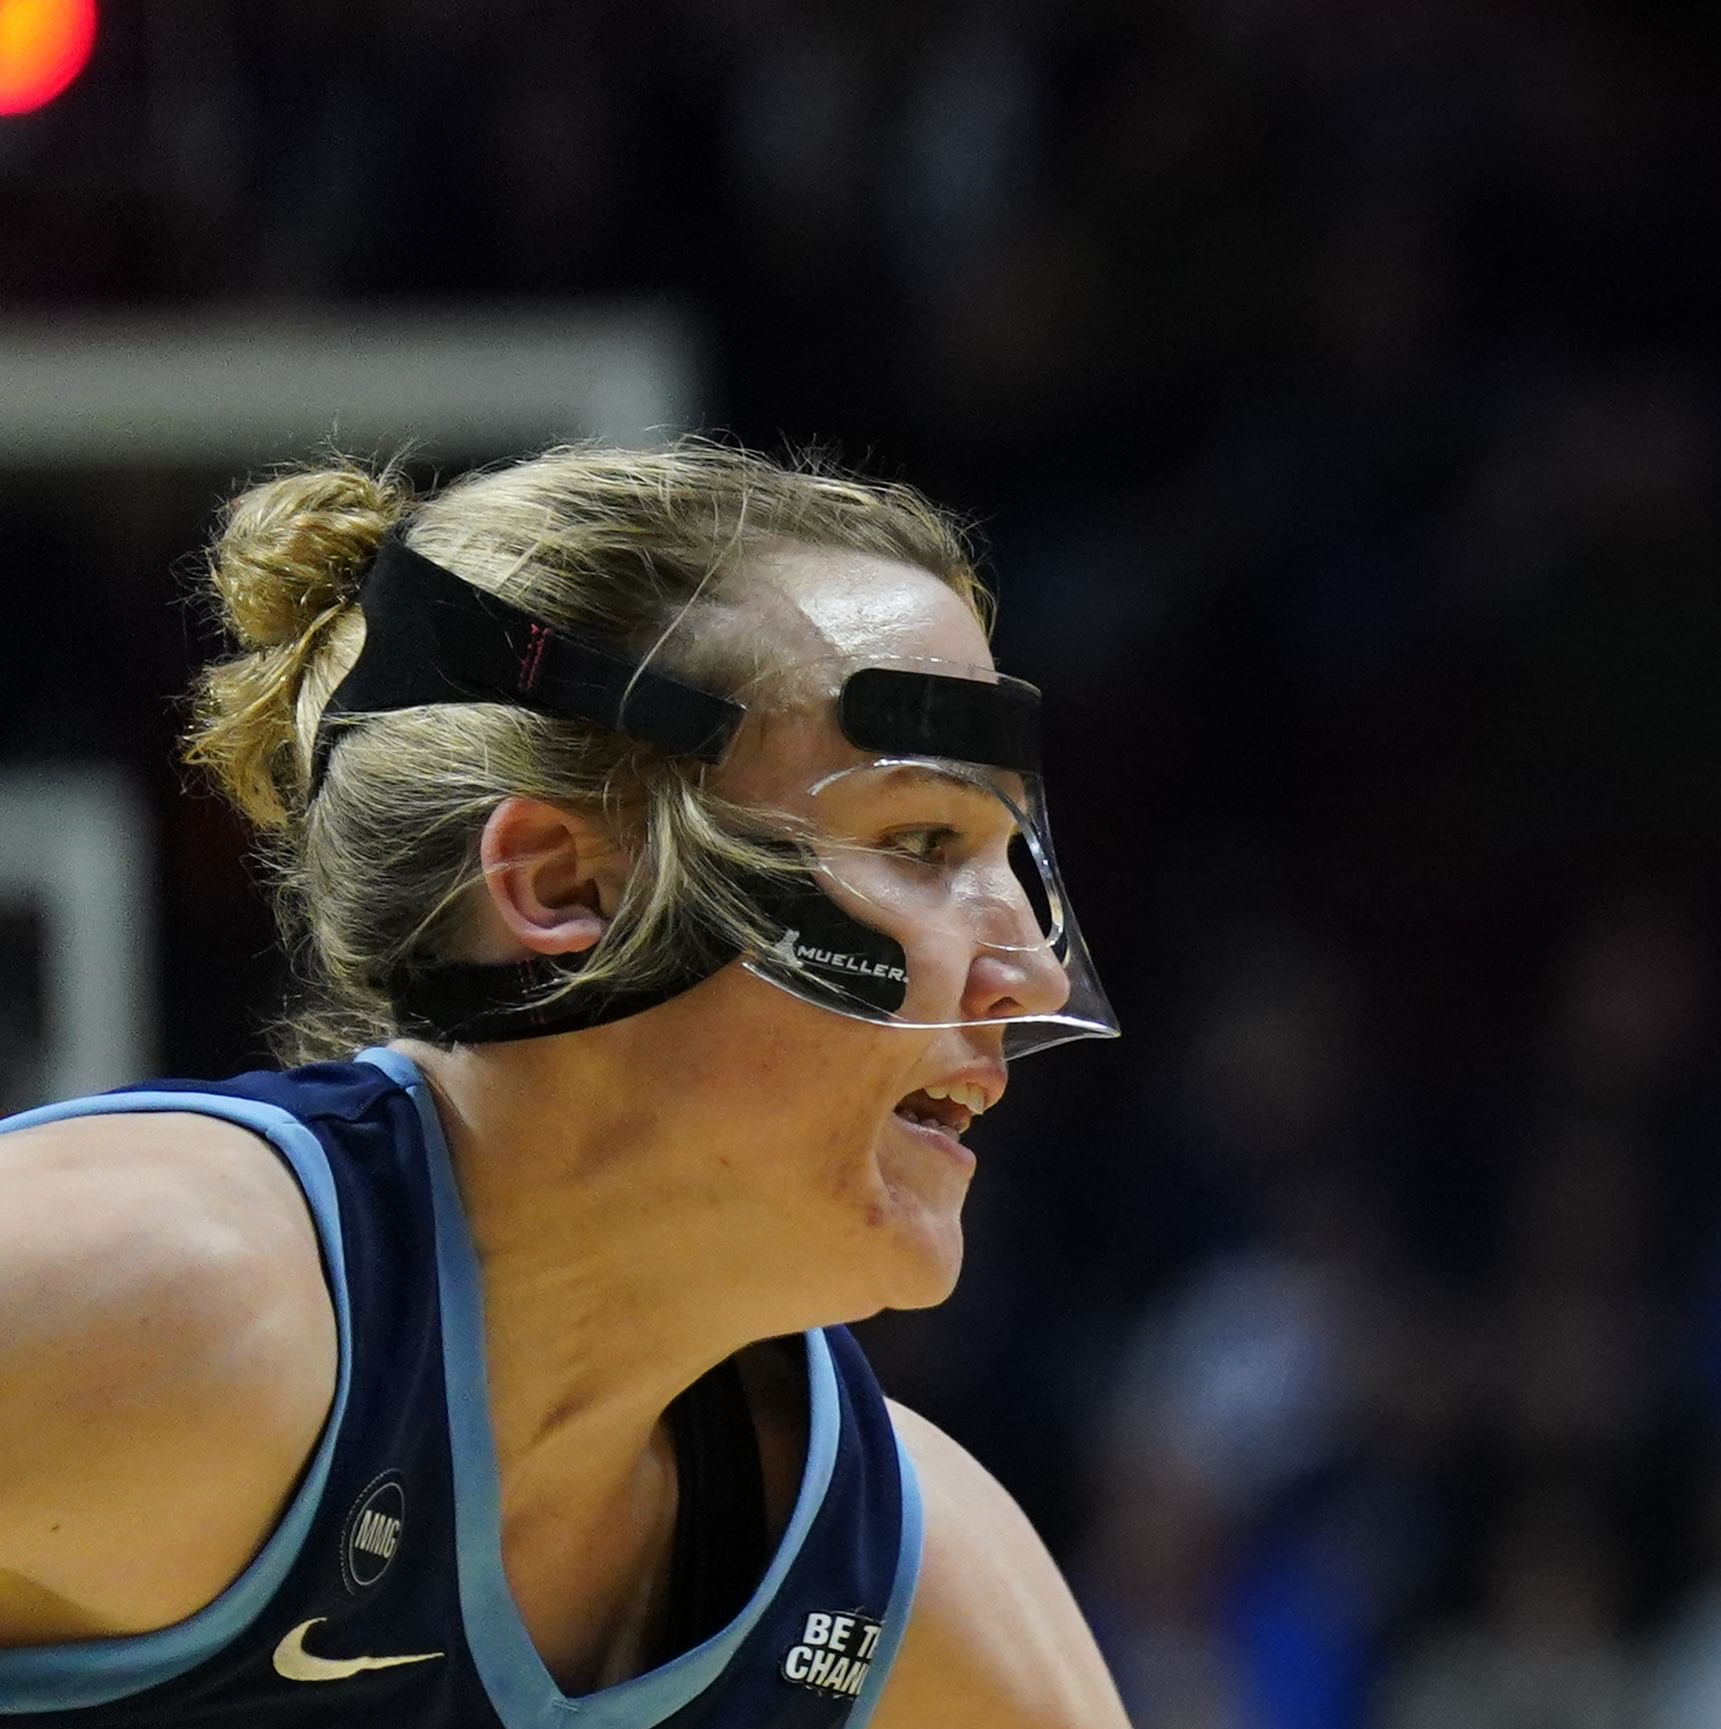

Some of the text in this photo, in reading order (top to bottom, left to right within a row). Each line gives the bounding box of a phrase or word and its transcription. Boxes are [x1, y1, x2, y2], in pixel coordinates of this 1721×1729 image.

[354, 1510, 401, 1558] MMG
[802, 1613, 856, 1652] BE
[785, 1645, 870, 1696] CHAN
